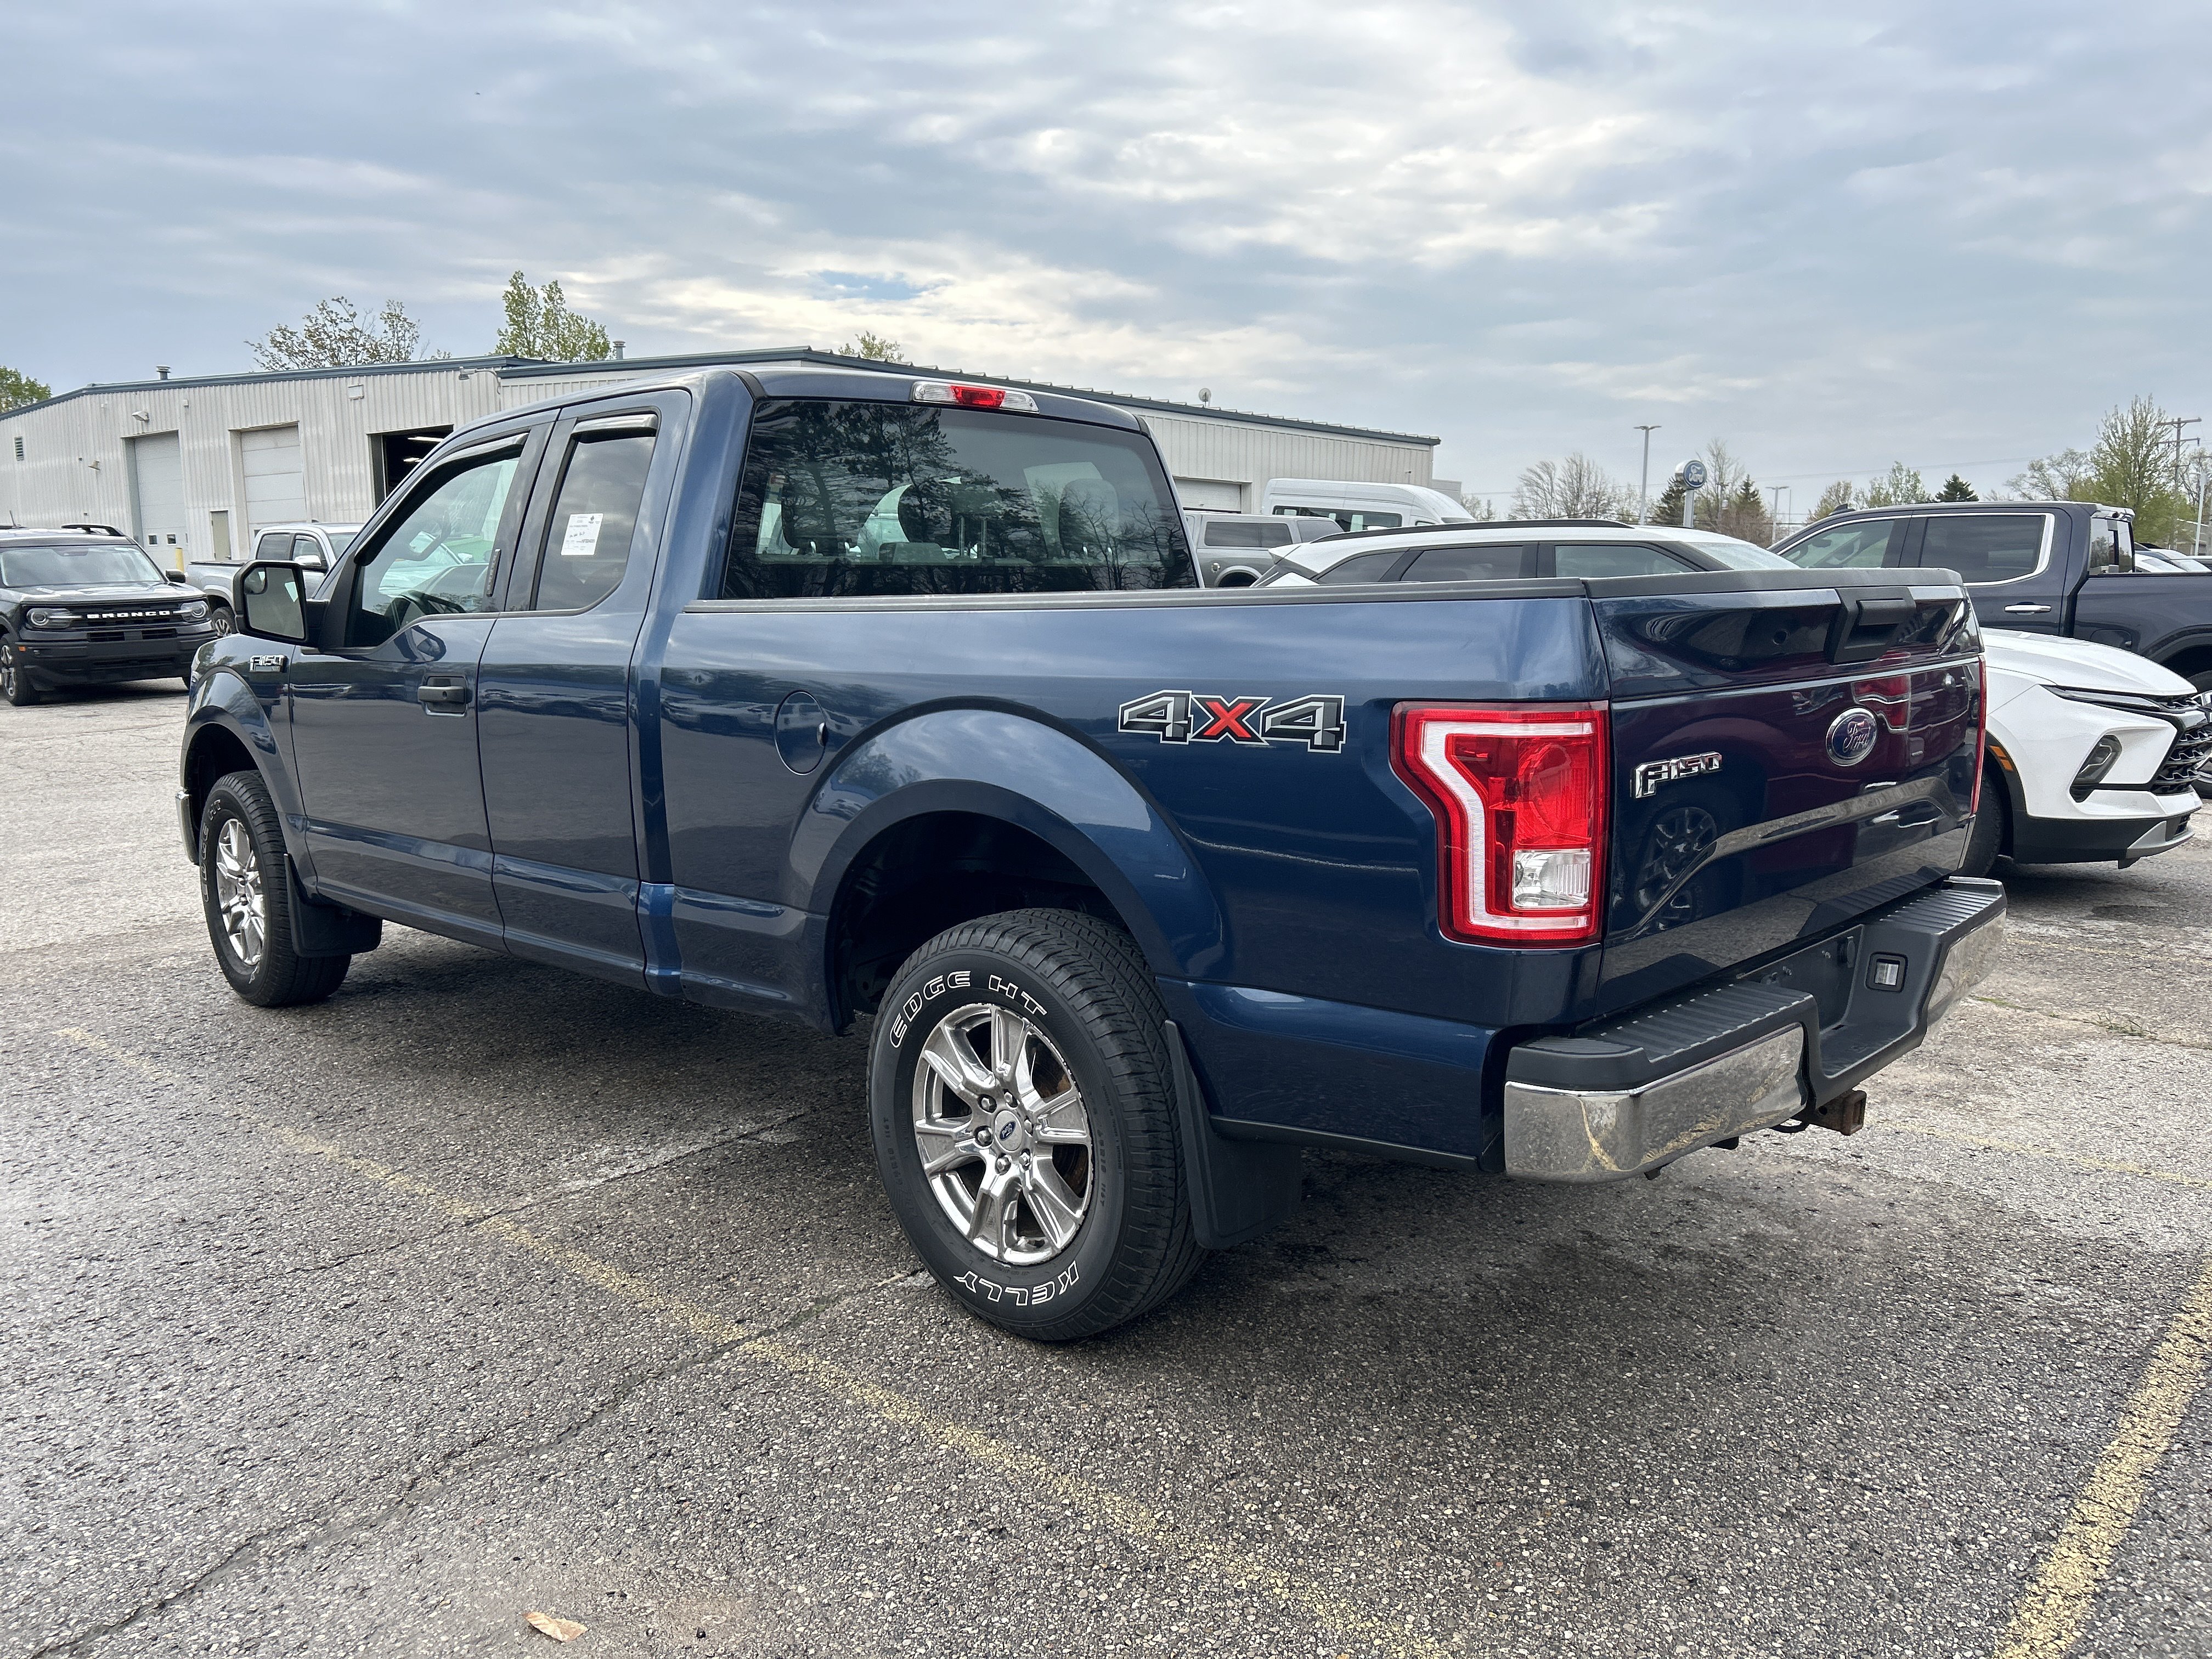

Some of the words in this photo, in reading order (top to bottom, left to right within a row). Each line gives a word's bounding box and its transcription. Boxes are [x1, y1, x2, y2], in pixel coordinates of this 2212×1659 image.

[87, 610, 170, 619] BRONCO
[207, 799, 221, 821] HT
[889, 970, 971, 1048] EDGE
[988, 974, 1048, 1015] HT
[953, 1260, 1080, 1306] KELLY
